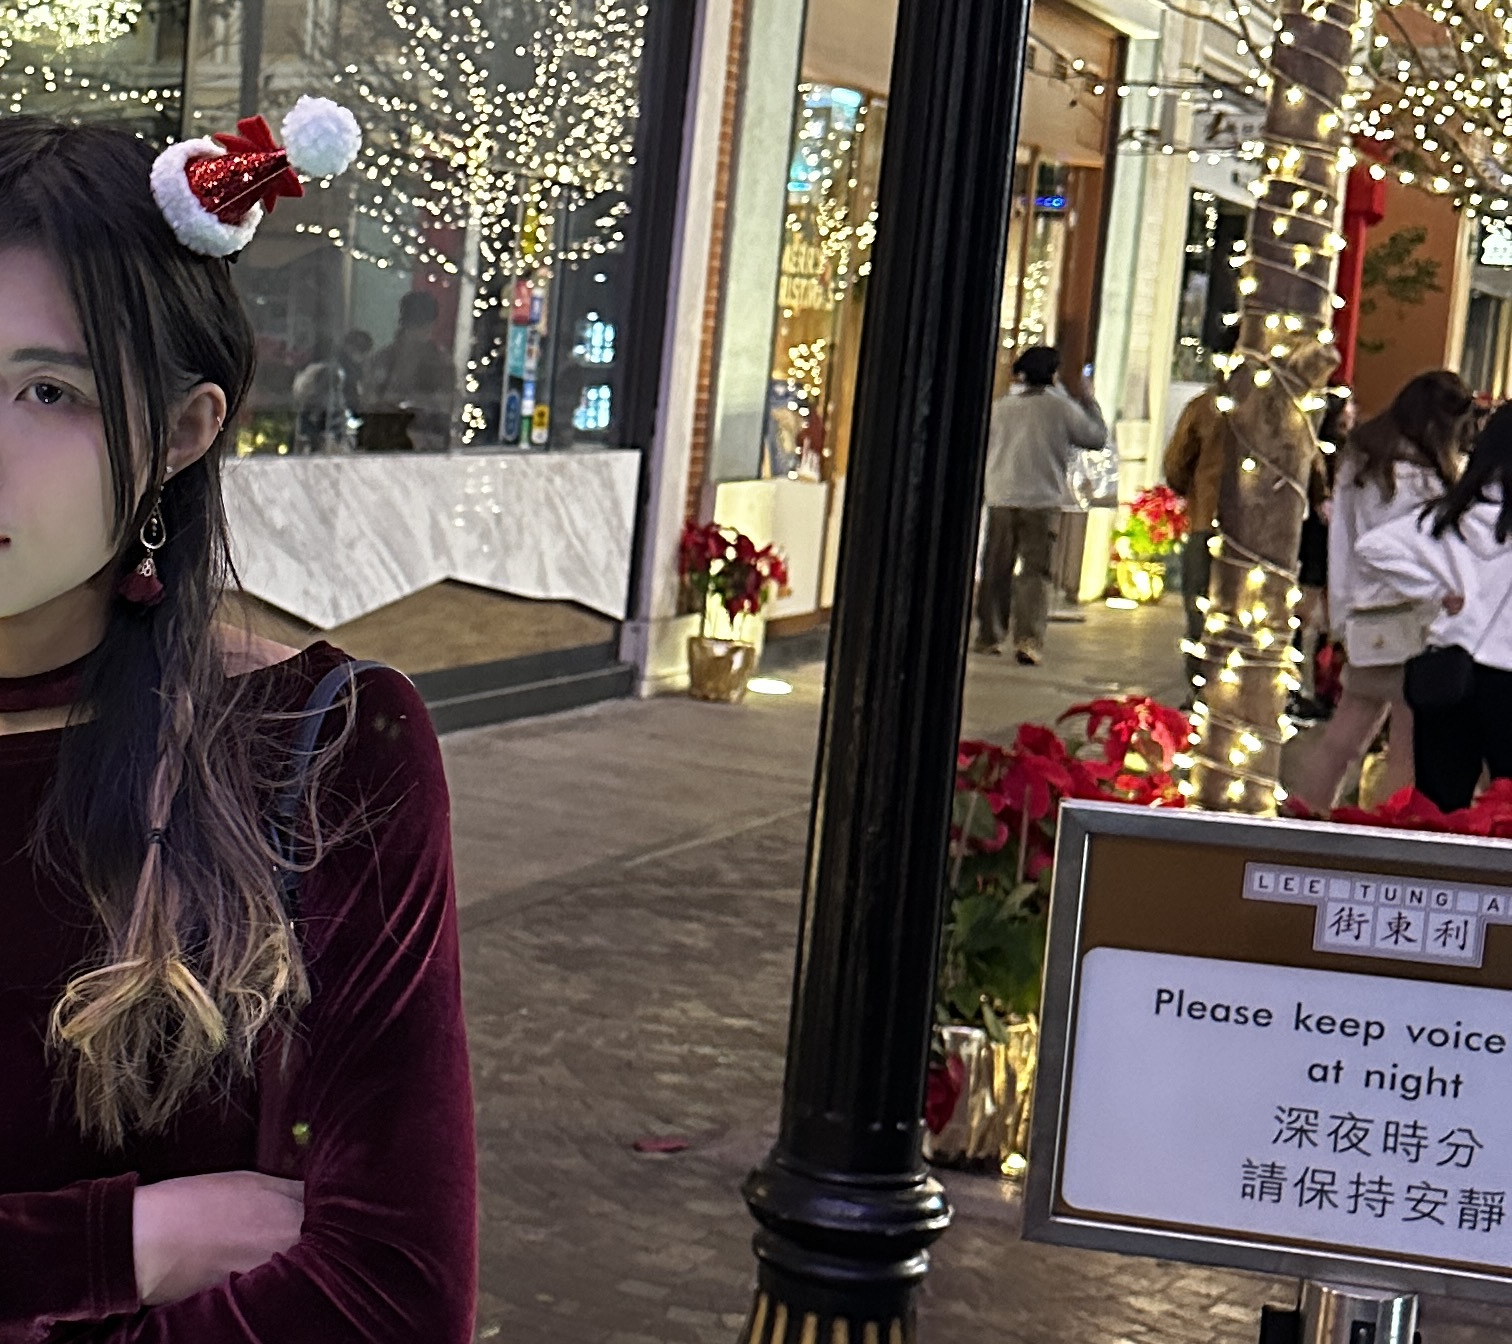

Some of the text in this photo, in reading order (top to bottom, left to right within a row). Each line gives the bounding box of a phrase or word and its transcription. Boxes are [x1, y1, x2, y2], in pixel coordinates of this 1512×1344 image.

[1258, 873, 1321, 896] LEE
[1359, 883, 1449, 908] TUNG
[1153, 988, 1507, 1054] Please keep voice
[1307, 1058, 1464, 1101] at night
[1271, 1104, 1484, 1168] 深夜時分
[1241, 1157, 1507, 1233] 請保持安靜
